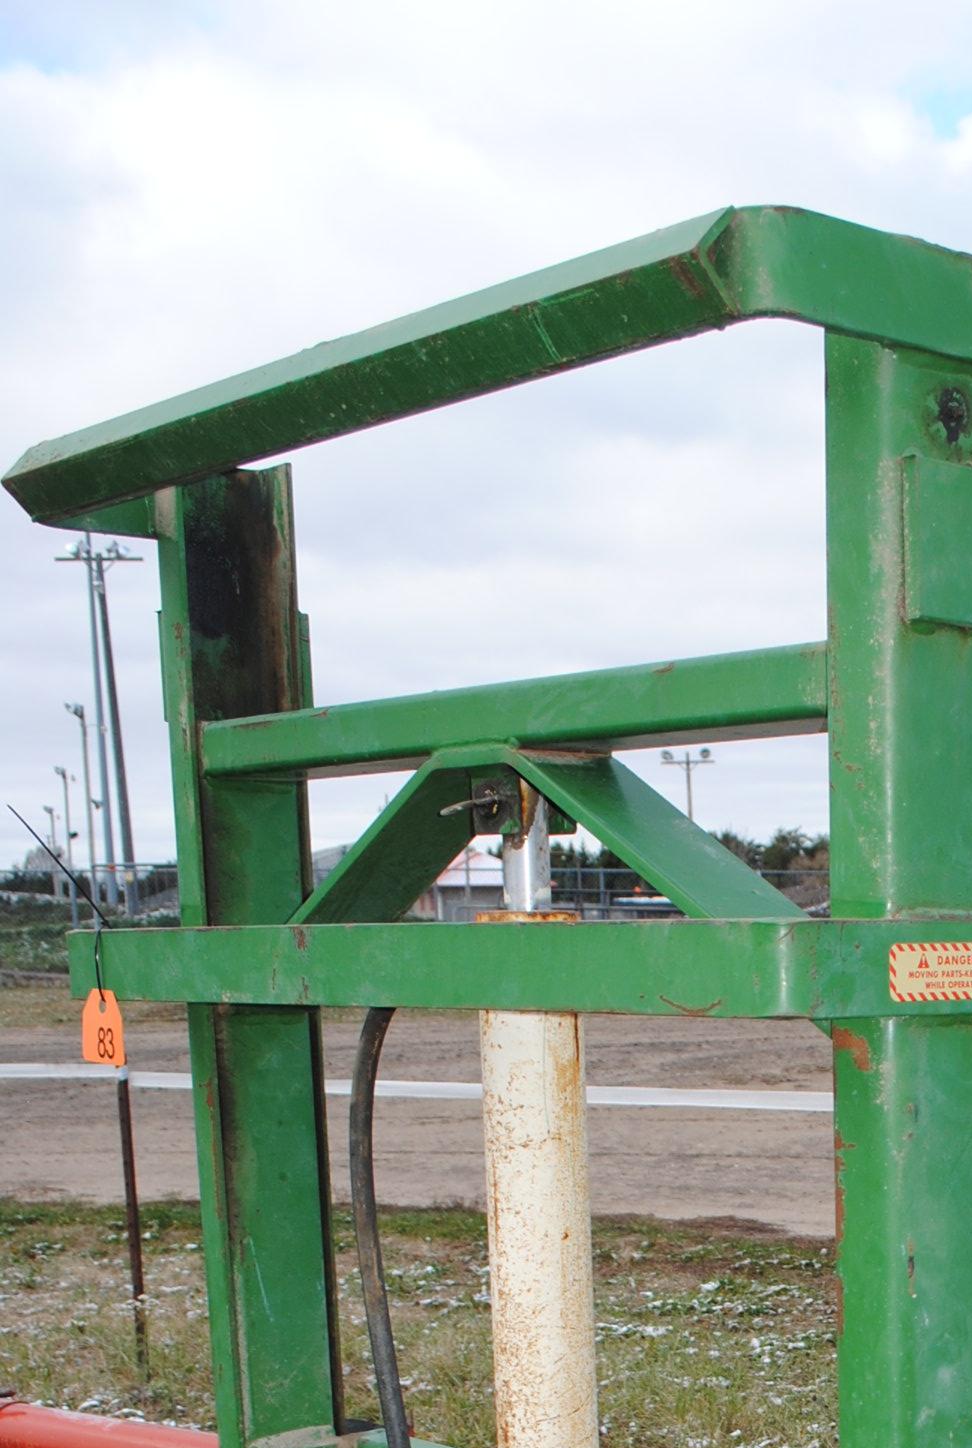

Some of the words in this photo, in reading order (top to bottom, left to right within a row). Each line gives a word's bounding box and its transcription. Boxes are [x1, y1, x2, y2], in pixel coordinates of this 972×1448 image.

[908, 970, 939, 979] MOVING
[925, 981, 945, 989] WHILE
[98, 1027, 115, 1059] 83
